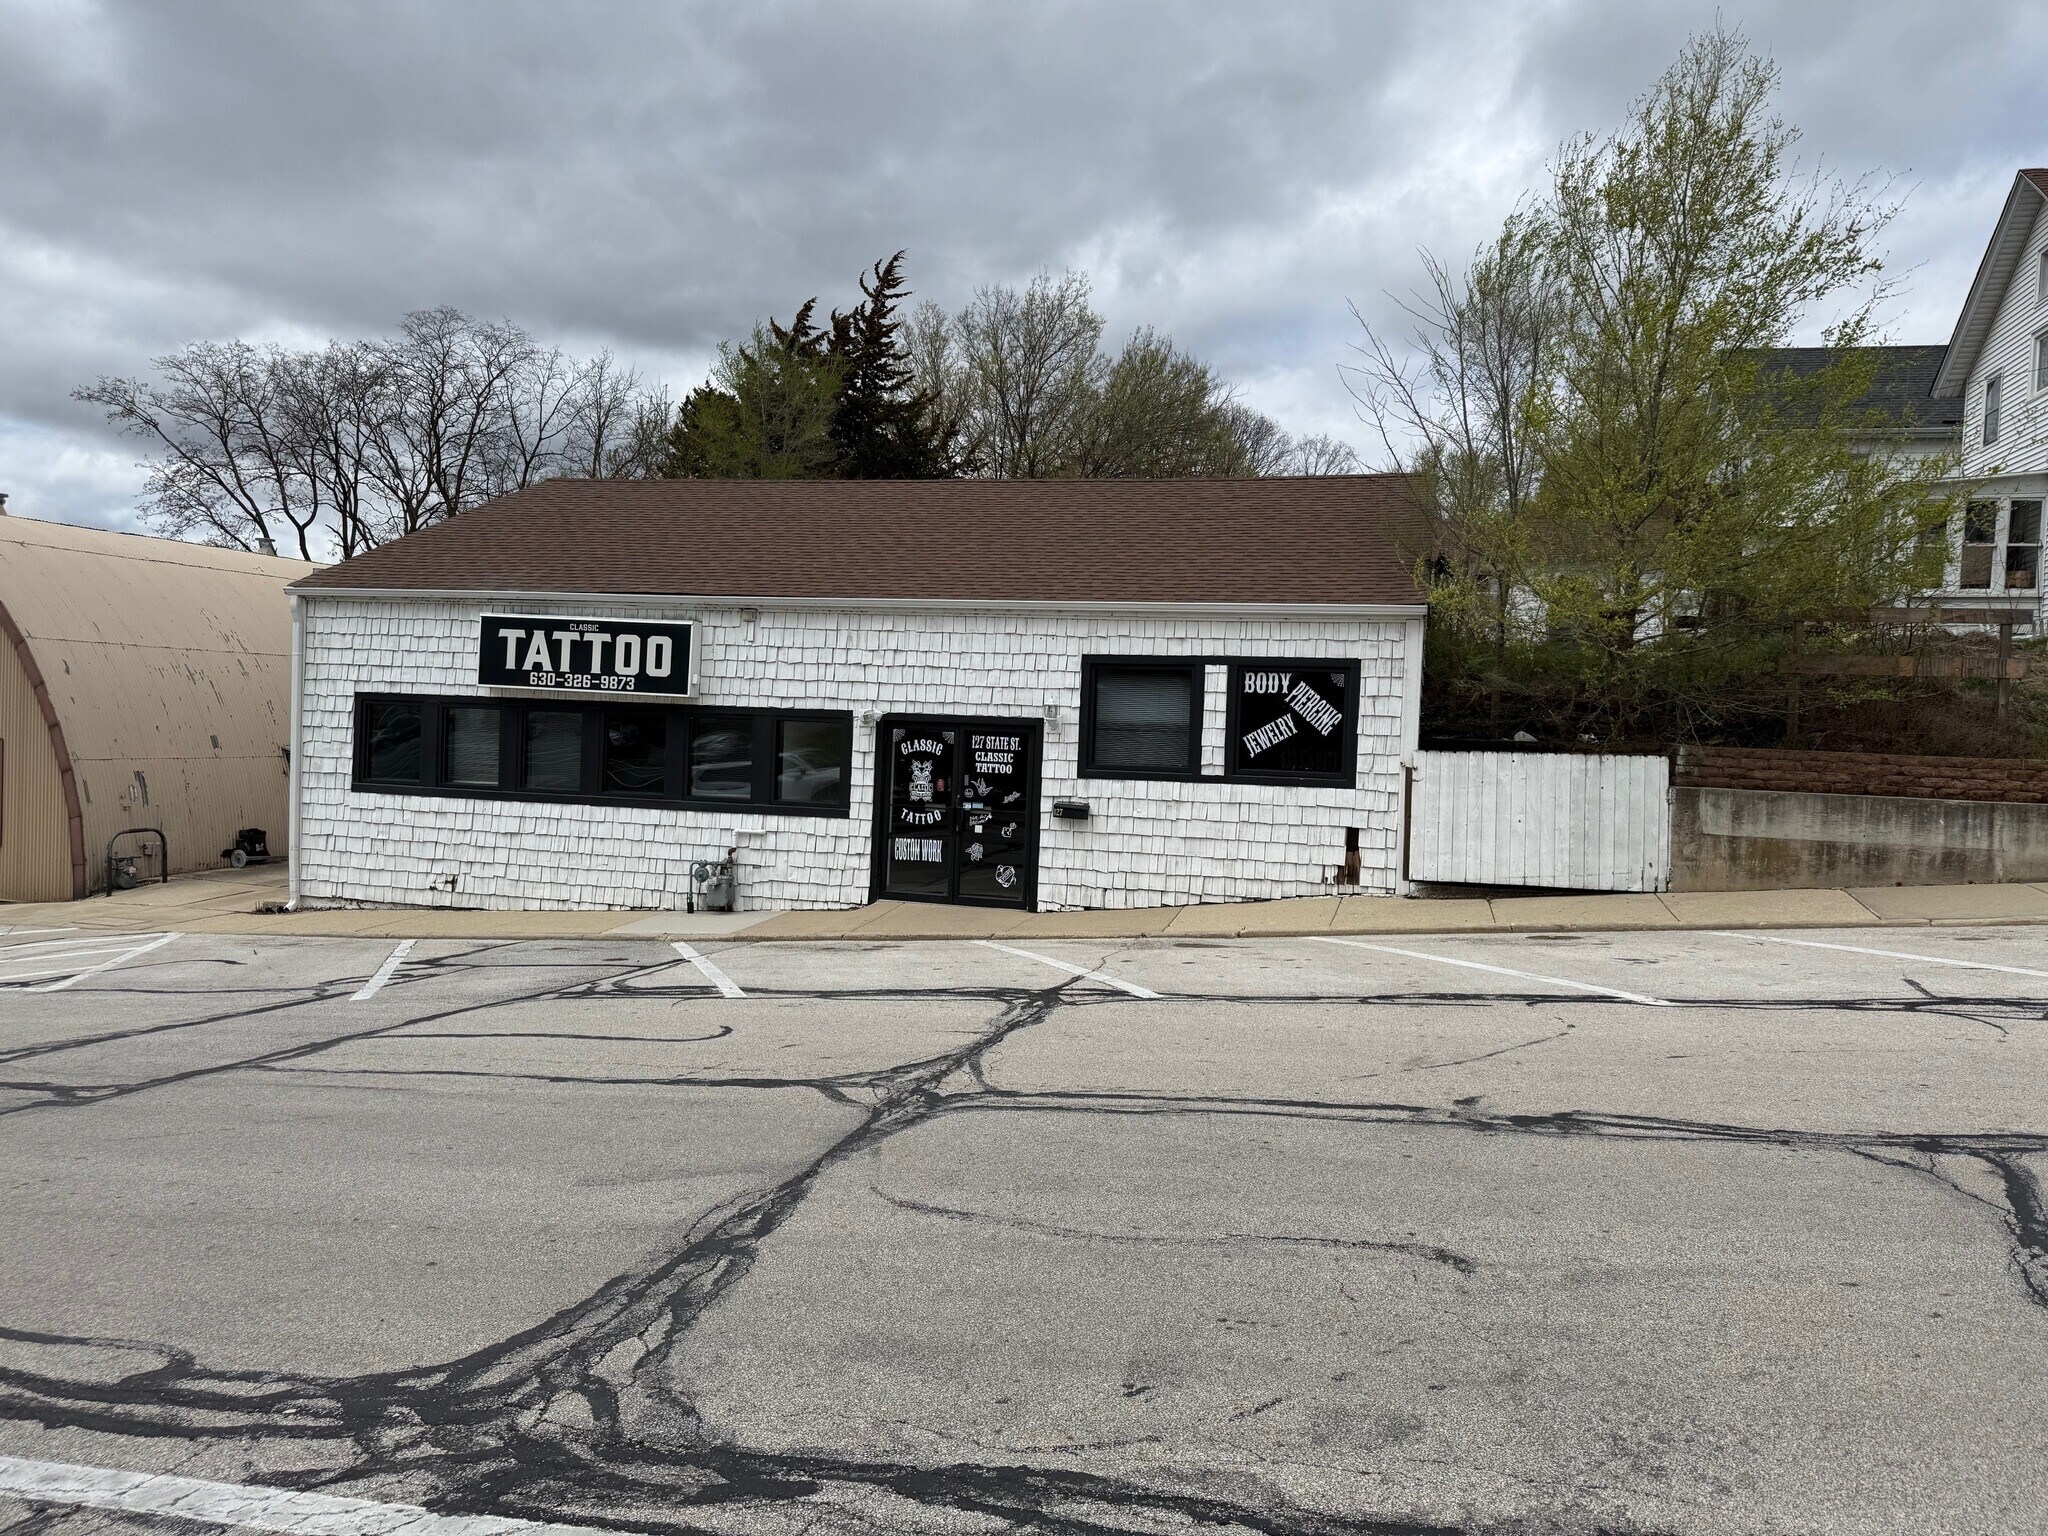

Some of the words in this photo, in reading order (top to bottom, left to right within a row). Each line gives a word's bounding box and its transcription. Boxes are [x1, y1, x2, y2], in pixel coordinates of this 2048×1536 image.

[569, 623, 599, 632] CLASSIC
[498, 628, 673, 678] TATTOO
[529, 672, 635, 690] 630-326-9873
[1244, 672, 1293, 694] BODY
[1284, 680, 1343, 737] PIERCING
[972, 735, 985, 749] 127
[986, 736, 1009, 750] STATE
[1010, 737, 1022, 751] ST.
[1242, 712, 1298, 759] JEWELRY
[900, 738, 944, 756] CLASSIC
[975, 751, 1014, 763] CLASSIC
[975, 763, 1013, 774] TATTOO
[900, 807, 942, 825] TATTOO
[894, 837, 920, 861] CUSTOM
[921, 839, 943, 862] WORK
